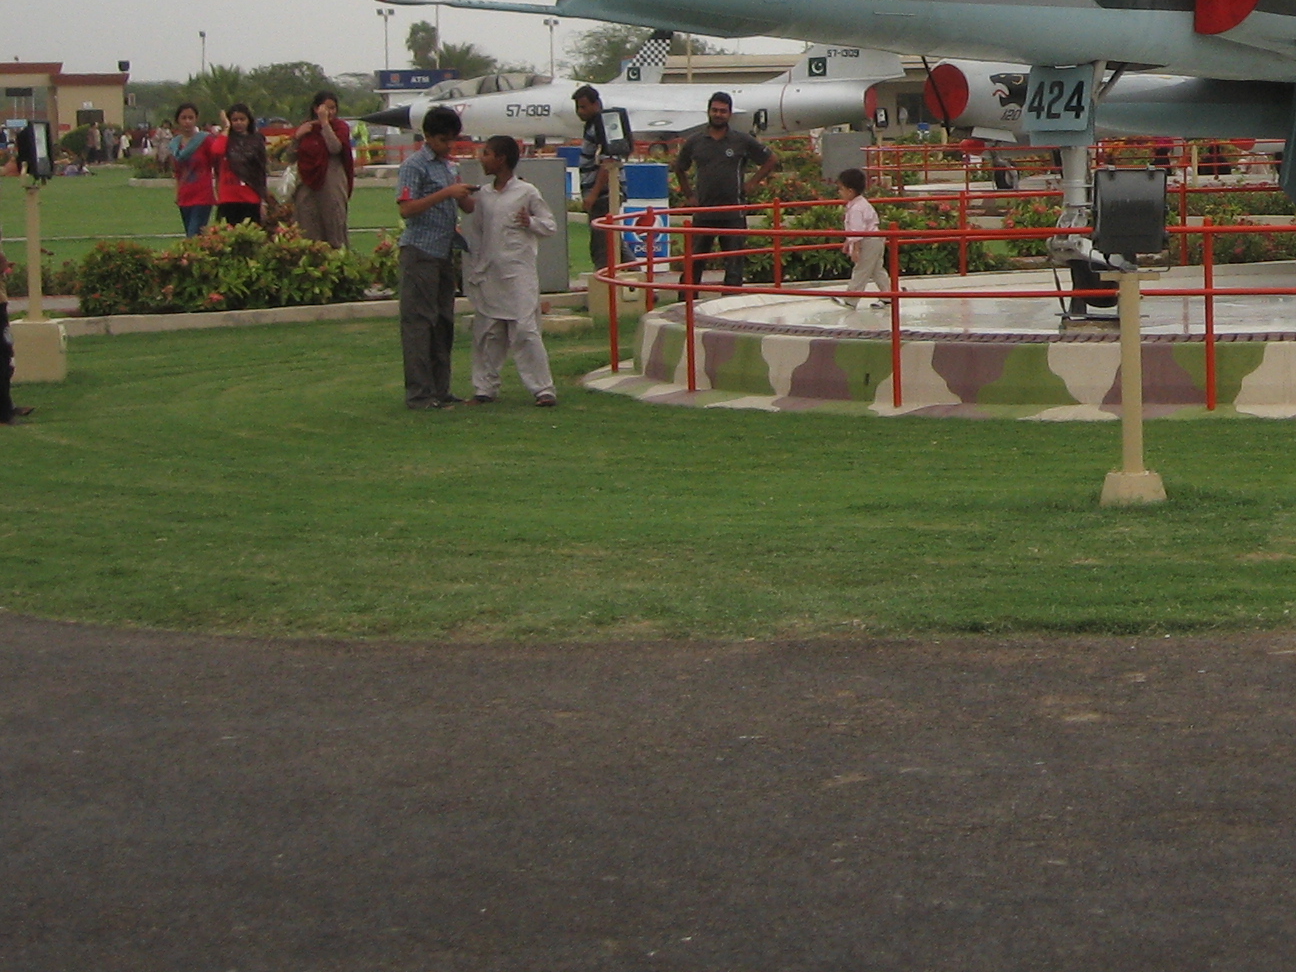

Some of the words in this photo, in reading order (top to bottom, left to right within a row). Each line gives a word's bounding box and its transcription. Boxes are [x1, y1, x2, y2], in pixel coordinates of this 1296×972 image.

[1027, 80, 1085, 119] 424
[506, 104, 551, 117] 57-1309
[1001, 109, 1022, 120] 120
[634, 244, 662, 253] pesi
